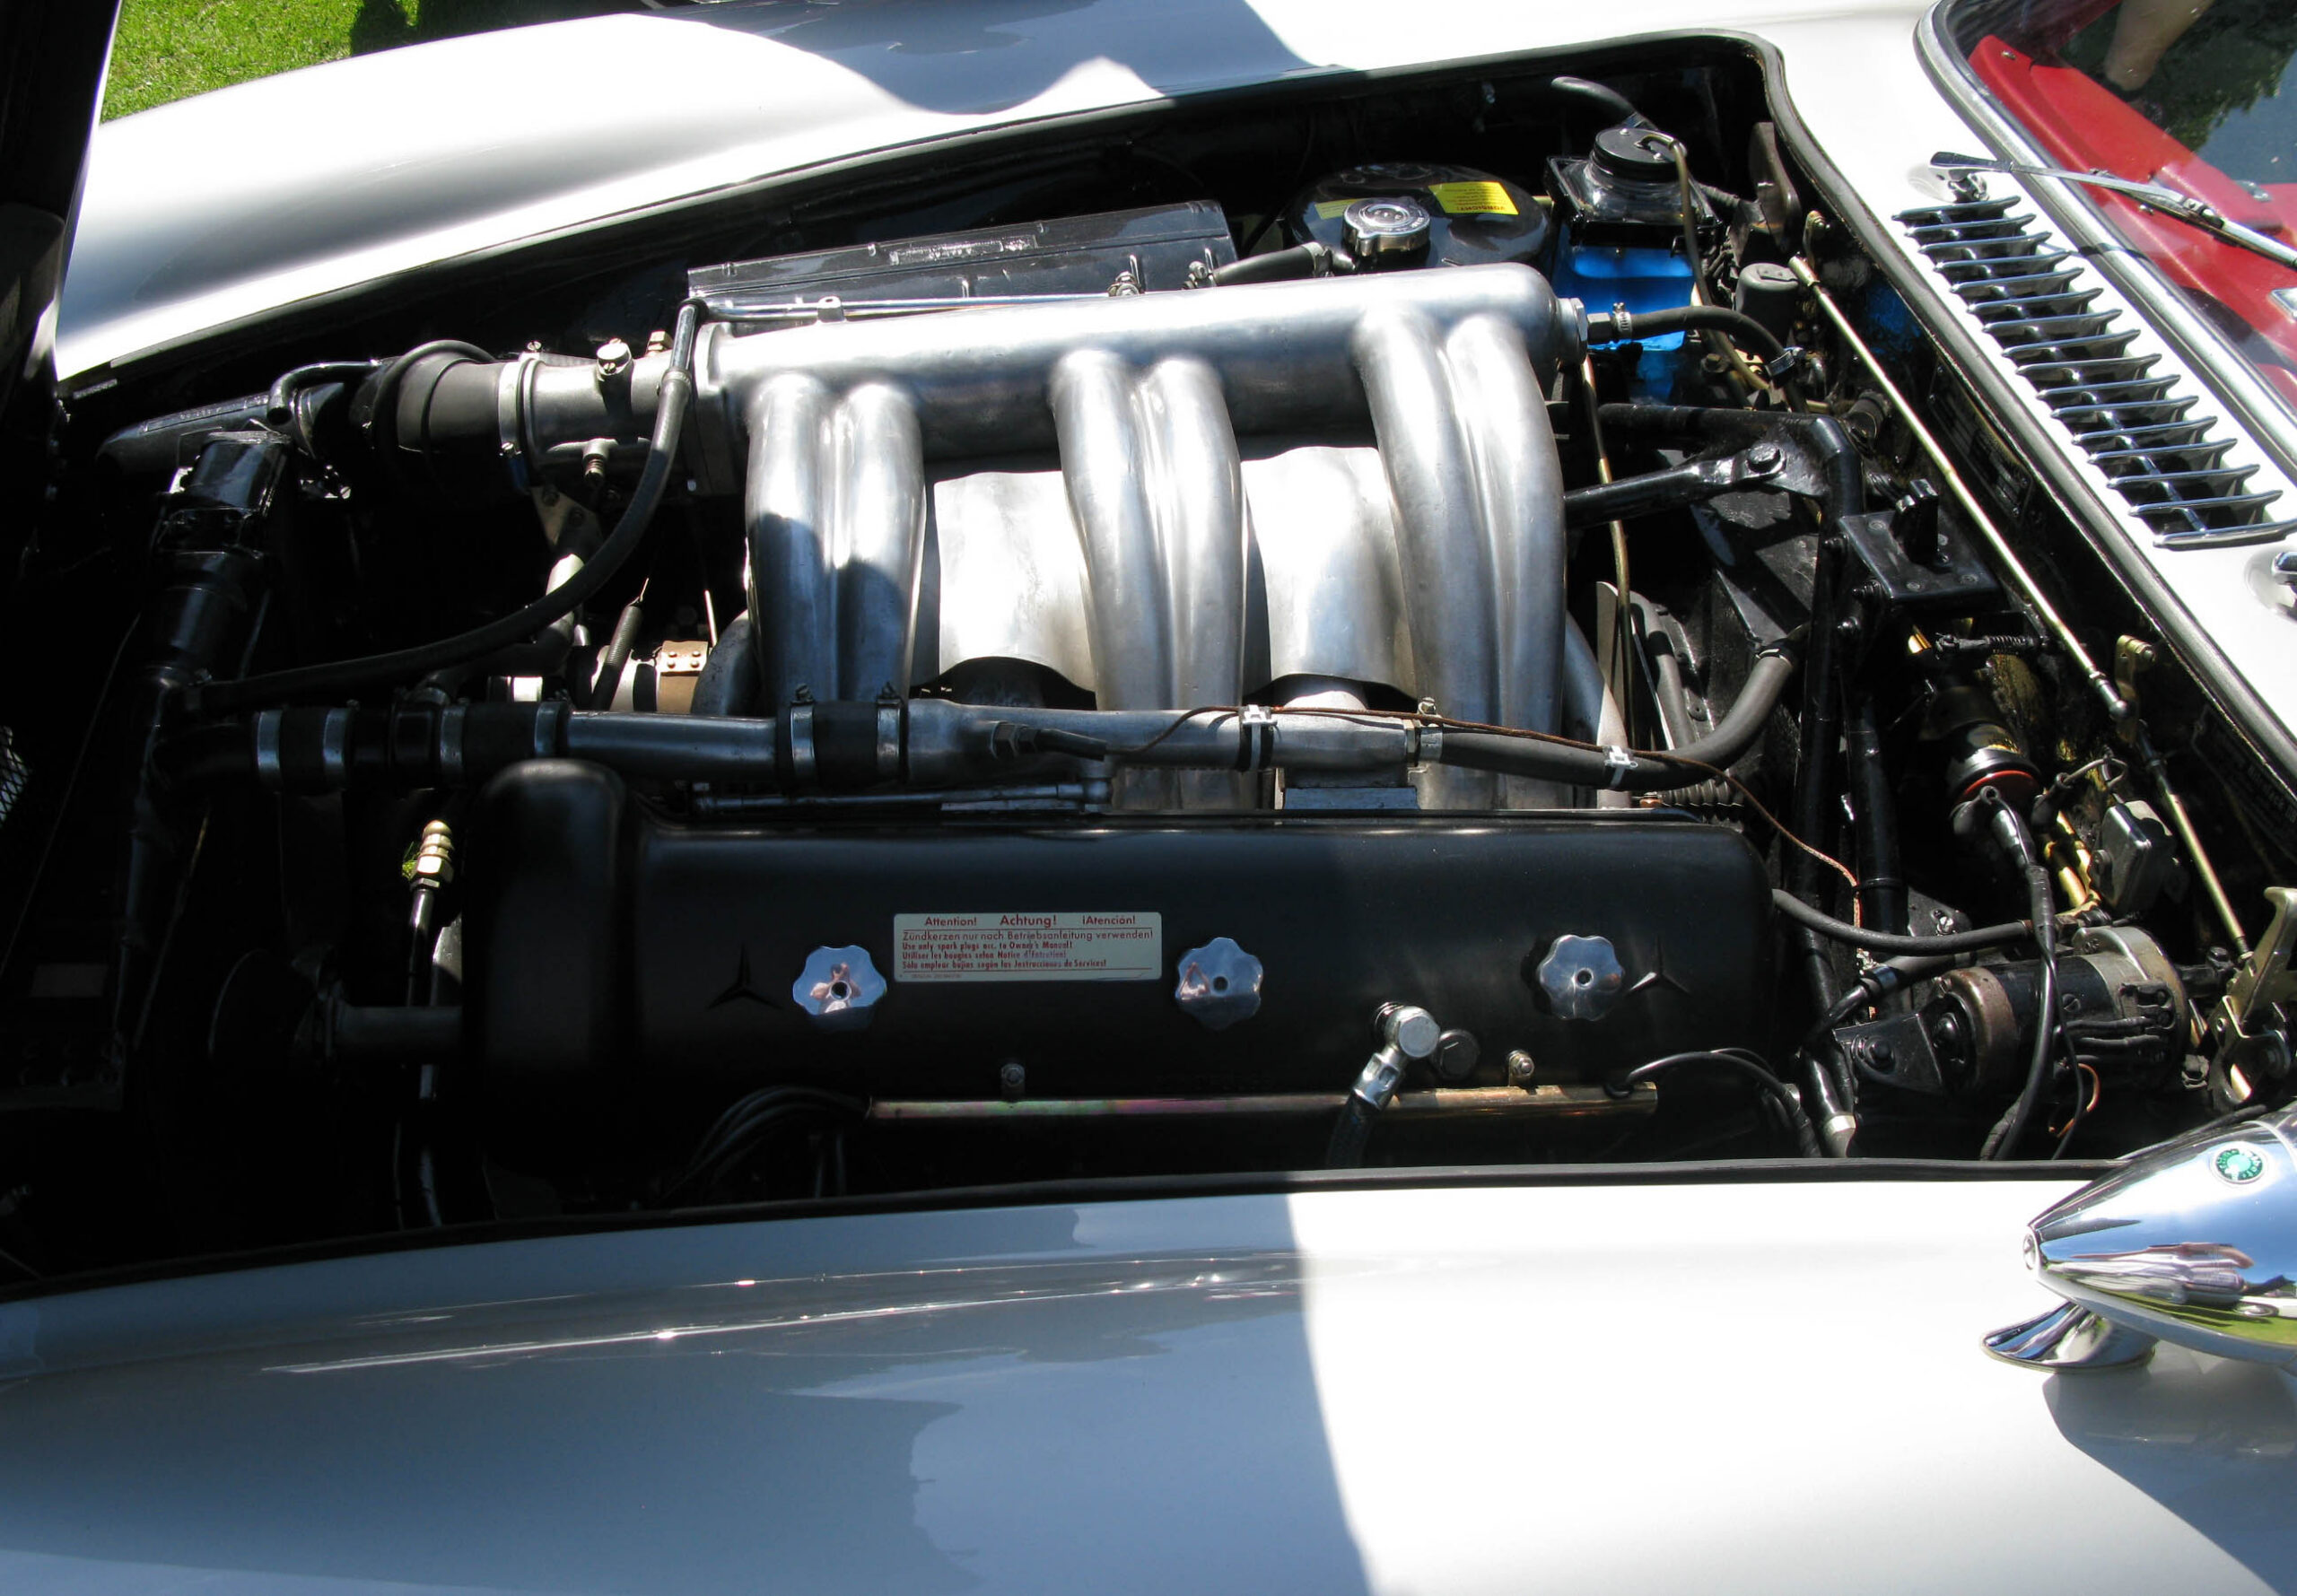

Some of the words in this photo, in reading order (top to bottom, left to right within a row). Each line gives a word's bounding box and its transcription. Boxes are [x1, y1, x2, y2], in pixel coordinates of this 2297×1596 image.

[924, 917, 977, 926] Attention!
[1000, 914, 1057, 928] Achtung!
[903, 930, 960, 941] Zündkerzen
[981, 929, 1004, 940] nach
[1008, 930, 1093, 941] Betriebsanleitung
[1096, 929, 1153, 939] verwenden!
[938, 942, 957, 951] spark
[960, 942, 979, 951] plugs
[1043, 940, 1073, 949] Manual!
